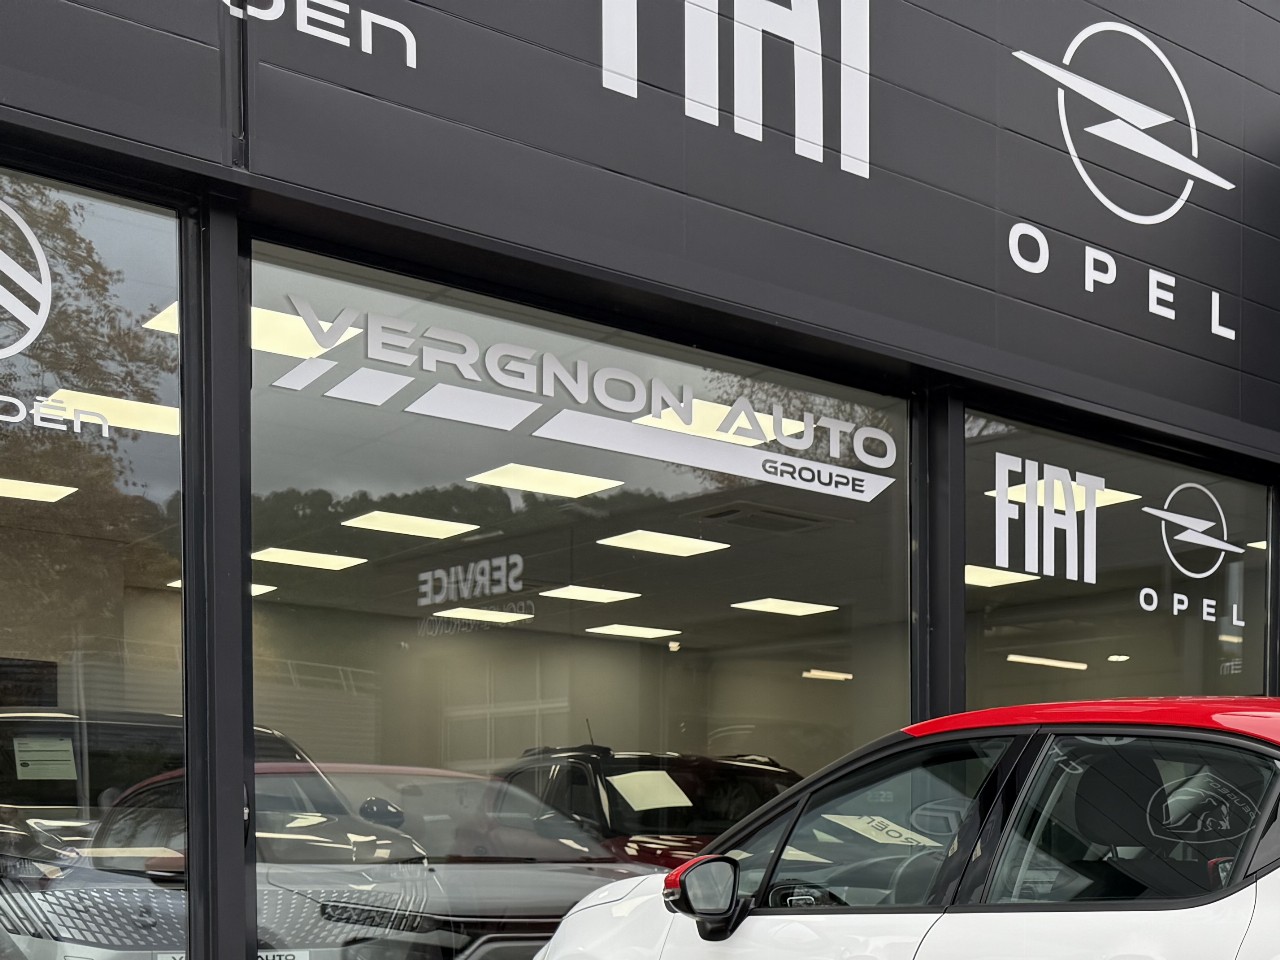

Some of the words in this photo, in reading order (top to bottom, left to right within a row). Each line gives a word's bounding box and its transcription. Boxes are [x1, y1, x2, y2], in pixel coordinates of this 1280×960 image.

[1008, 222, 1236, 340] OPEL
[287, 293, 693, 426] VERGNON
[716, 396, 897, 469] AUTO
[761, 458, 865, 494] GROUPE
[995, 452, 1105, 584] FIAT
[1139, 587, 1246, 627] OPEL
